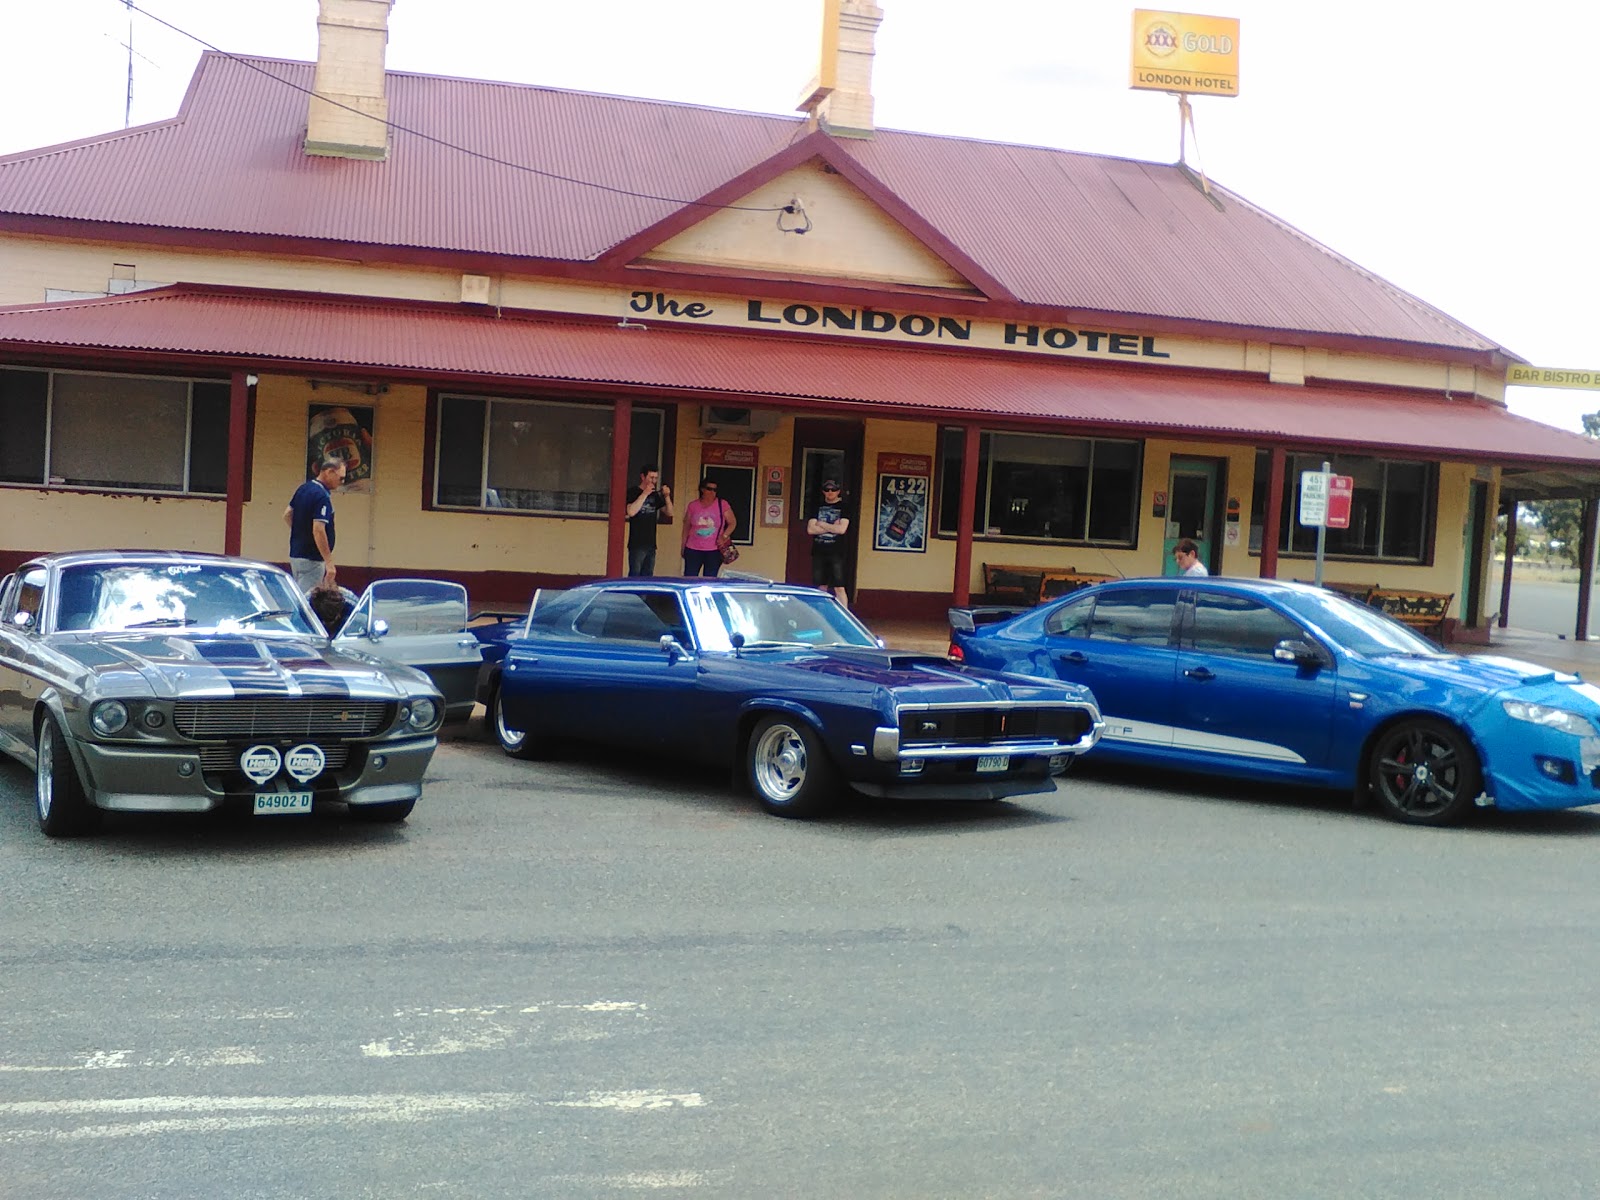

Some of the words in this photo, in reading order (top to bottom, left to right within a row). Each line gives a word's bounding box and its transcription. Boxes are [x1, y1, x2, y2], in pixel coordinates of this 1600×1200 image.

[1183, 32, 1233, 55] GOLD
[1139, 72, 1191, 85] LONDON
[1194, 78, 1234, 89] HOTEL
[629, 291, 713, 318] The
[747, 299, 972, 341] LONDON
[1004, 323, 1170, 358] HOTEL
[1513, 369, 1540, 381] BAR
[1543, 371, 1591, 384] BISTRO
[257, 796, 297, 808] 64902
[301, 794, 309, 807] D
